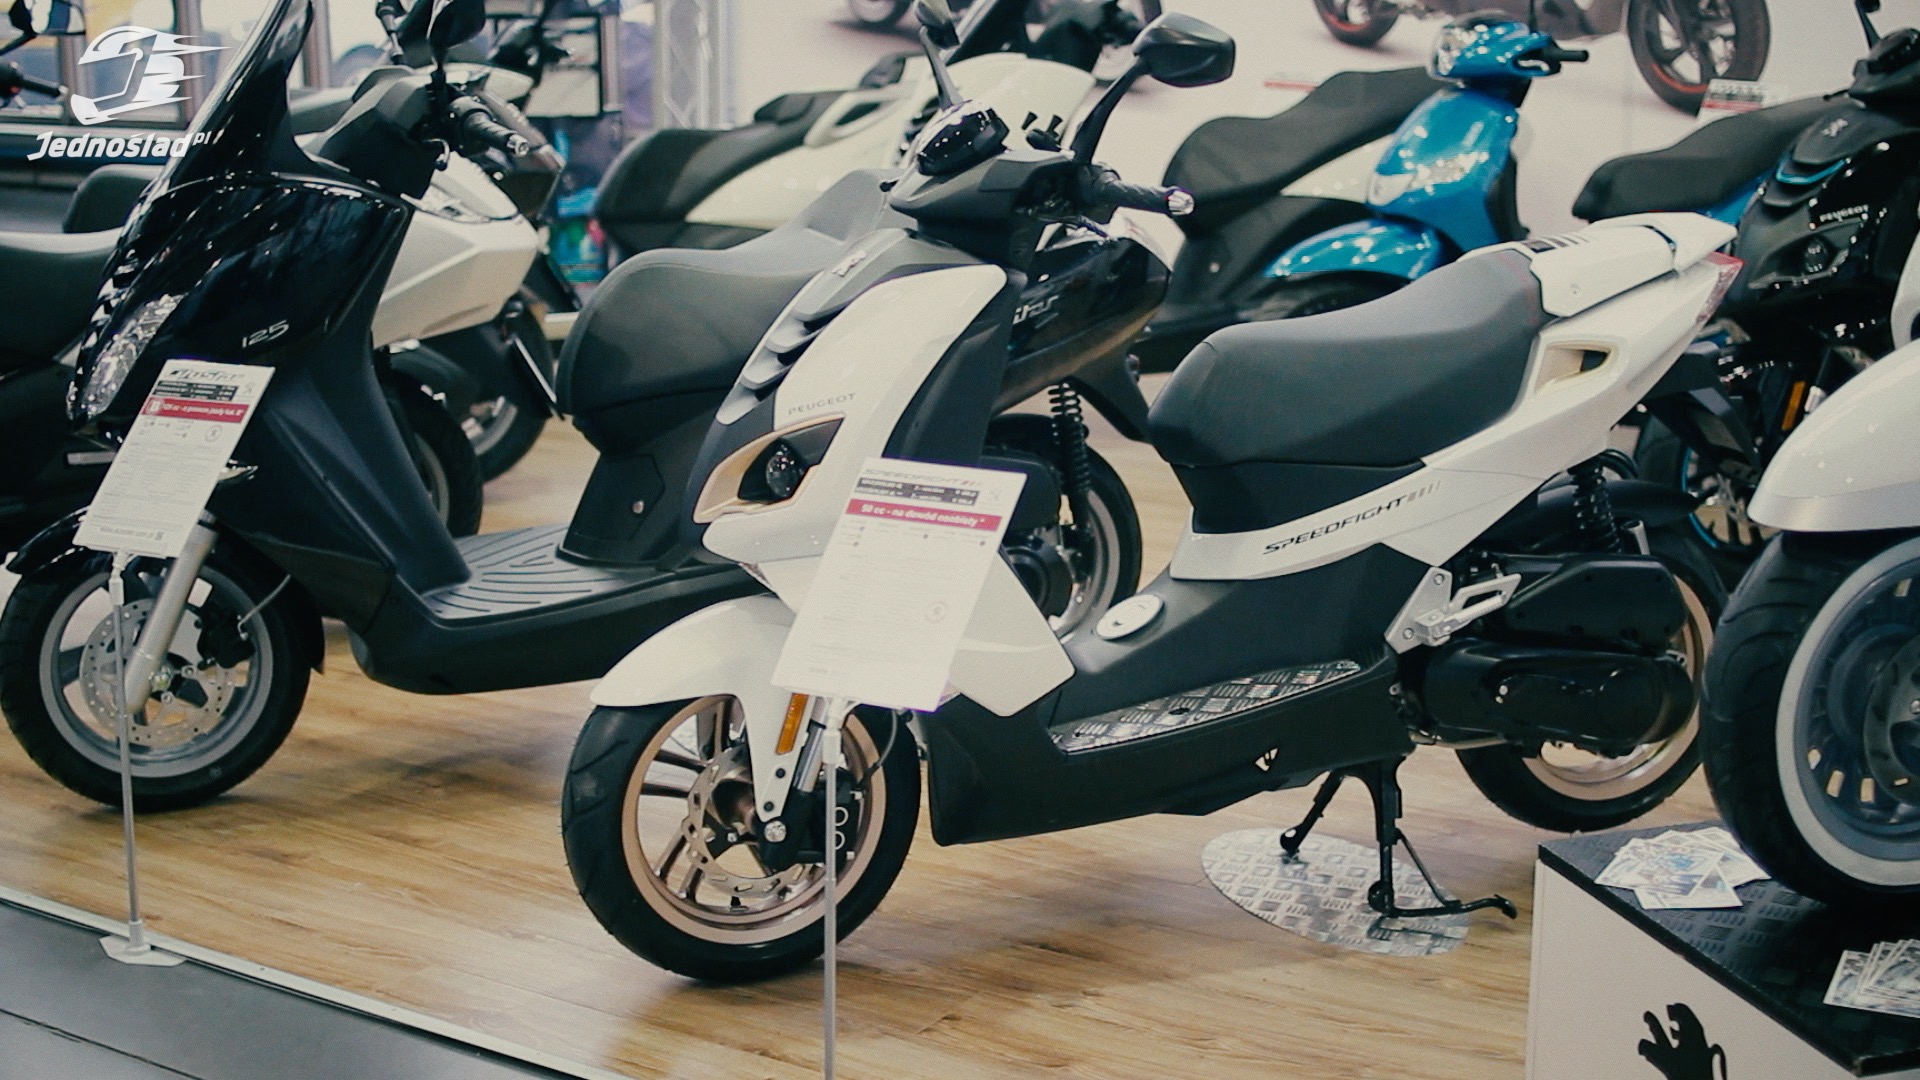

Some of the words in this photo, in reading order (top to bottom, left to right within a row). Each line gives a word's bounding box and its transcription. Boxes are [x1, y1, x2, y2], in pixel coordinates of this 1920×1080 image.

[1819, 204, 1869, 222] PEUGEOT
[242, 319, 289, 348] 125
[788, 392, 857, 415] PEUGEOT
[1263, 494, 1407, 555] SPEEDFIGHT
